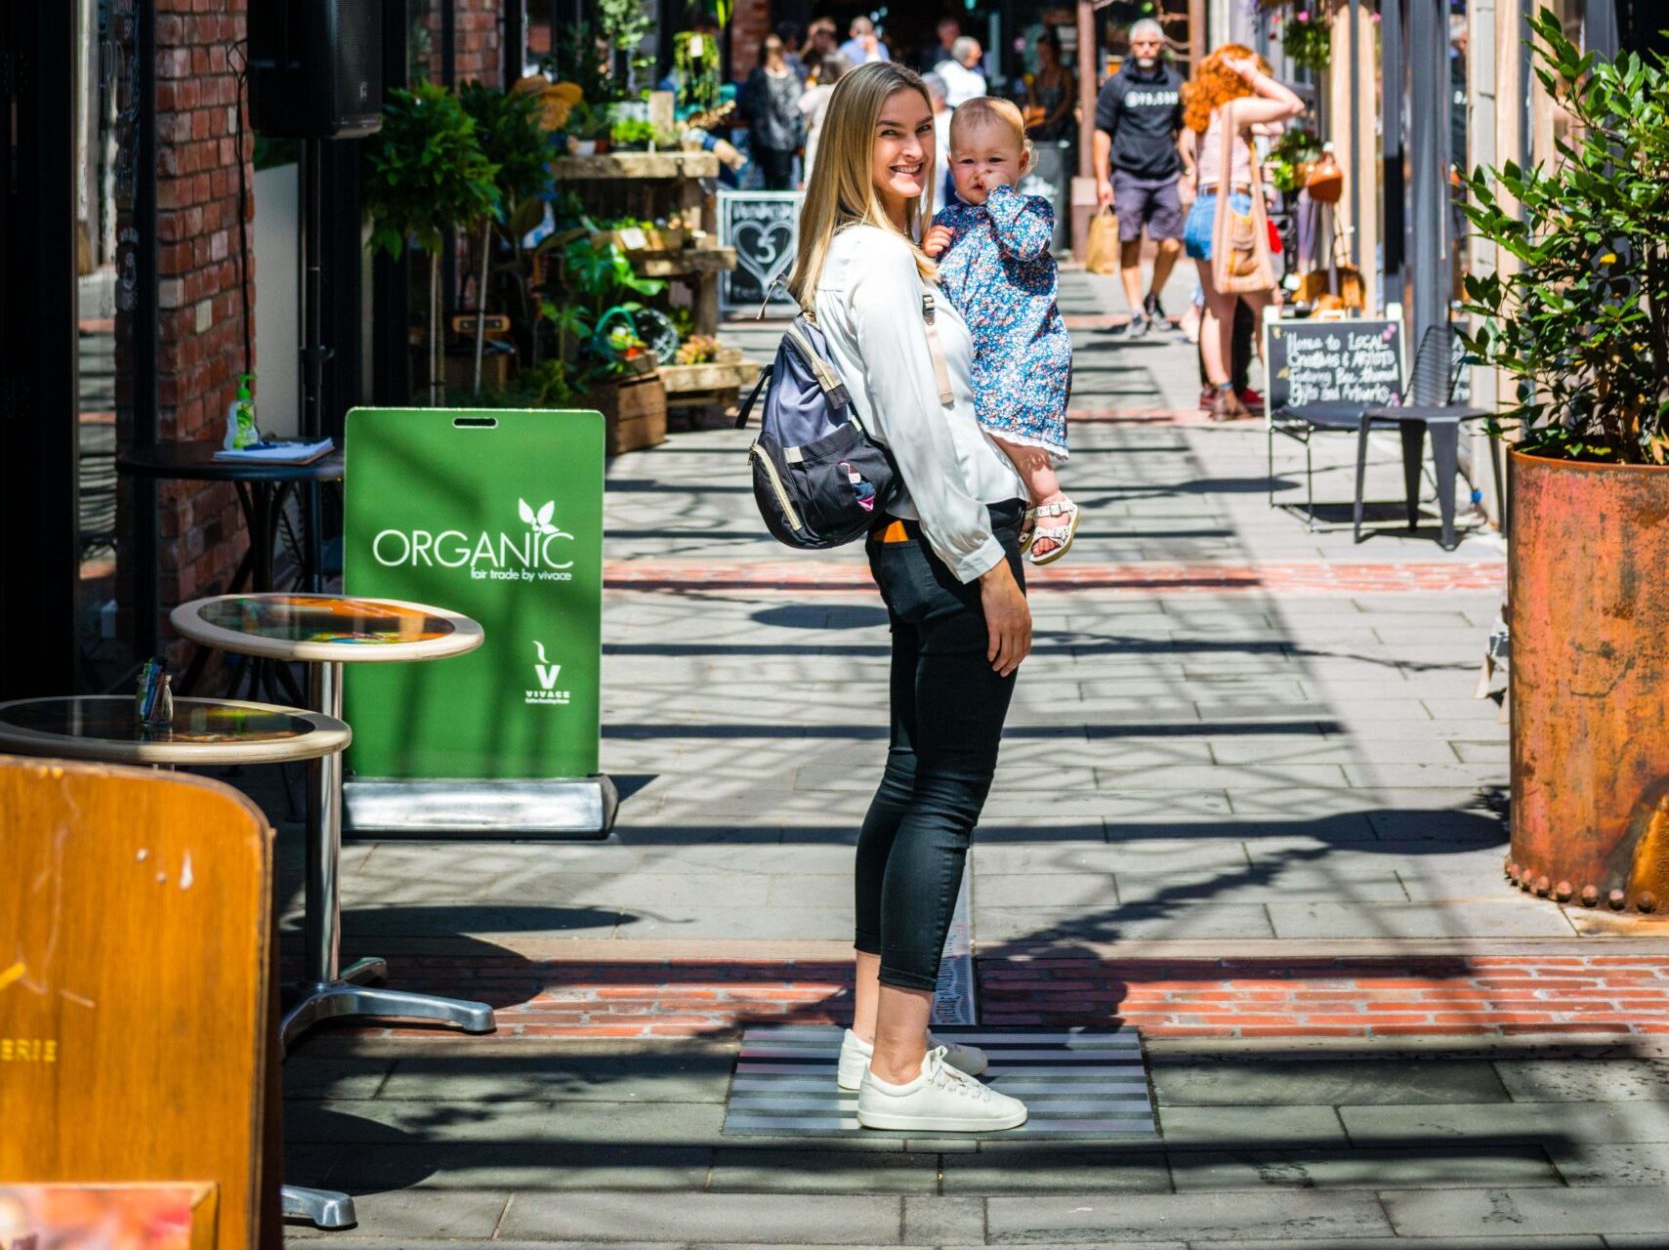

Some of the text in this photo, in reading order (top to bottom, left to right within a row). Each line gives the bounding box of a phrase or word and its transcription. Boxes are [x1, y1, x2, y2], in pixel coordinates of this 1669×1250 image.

[1325, 333, 1341, 351] to
[373, 529, 574, 569] ORGANIC
[471, 567, 487, 579] fair
[490, 567, 519, 580] trade
[521, 569, 535, 582] by
[525, 690, 570, 698] VIVACE
